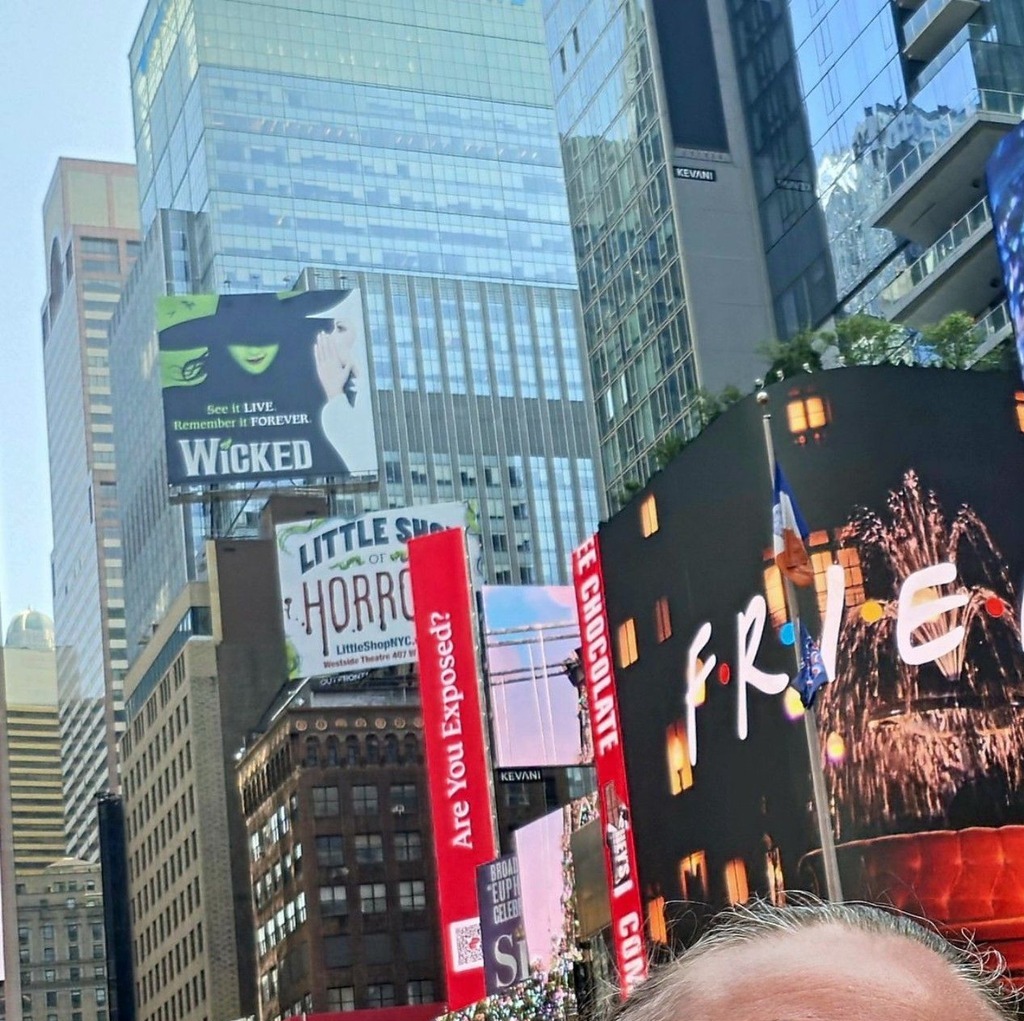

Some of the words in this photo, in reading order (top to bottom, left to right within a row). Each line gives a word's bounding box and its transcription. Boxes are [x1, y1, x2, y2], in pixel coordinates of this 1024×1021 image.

[676, 168, 714, 180] KEVANI
[207, 404, 229, 415] See
[232, 403, 240, 413] it
[173, 419, 235, 431] Remember
[239, 418, 247, 428] it
[299, 518, 389, 574] LITTLE
[395, 516, 449, 544] SH
[368, 553, 386, 564] OF
[323, 658, 359, 669] Westside
[361, 652, 390, 664] Theatre
[581, 577, 619, 756] CHOCOLATE
[430, 611, 464, 740] Exposed?
[447, 740, 468, 800] You
[501, 770, 541, 782] KEVANI
[451, 801, 473, 850] Are
